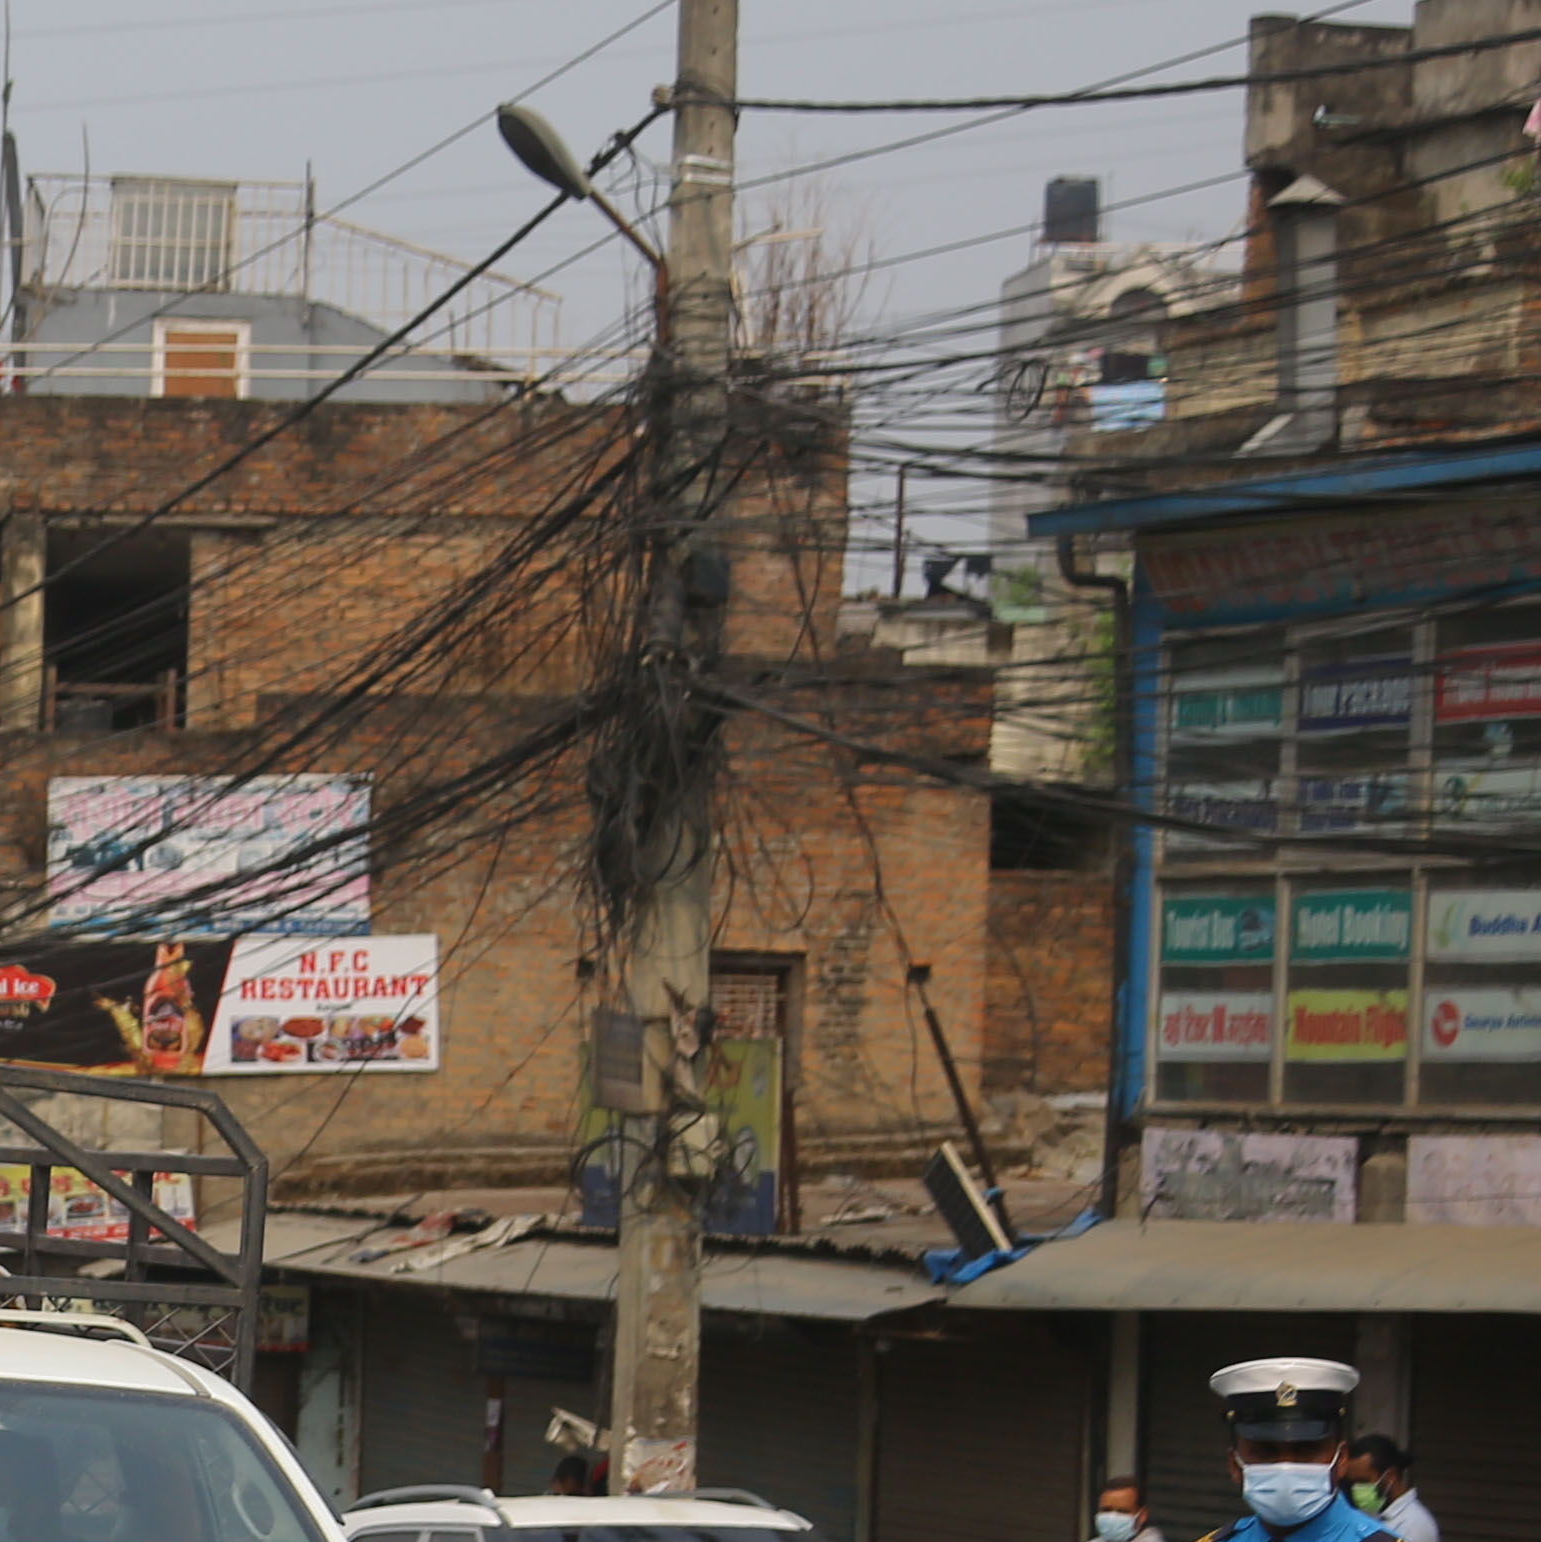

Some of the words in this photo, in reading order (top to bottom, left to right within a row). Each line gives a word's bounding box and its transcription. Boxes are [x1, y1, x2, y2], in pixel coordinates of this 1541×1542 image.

[1341, 903, 1406, 949] Booking
[1469, 915, 1527, 936] Buddha
[12, 977, 40, 996] Ice
[240, 974, 429, 1001] RESTAURANT
[1293, 1005, 1362, 1044] Mountain
